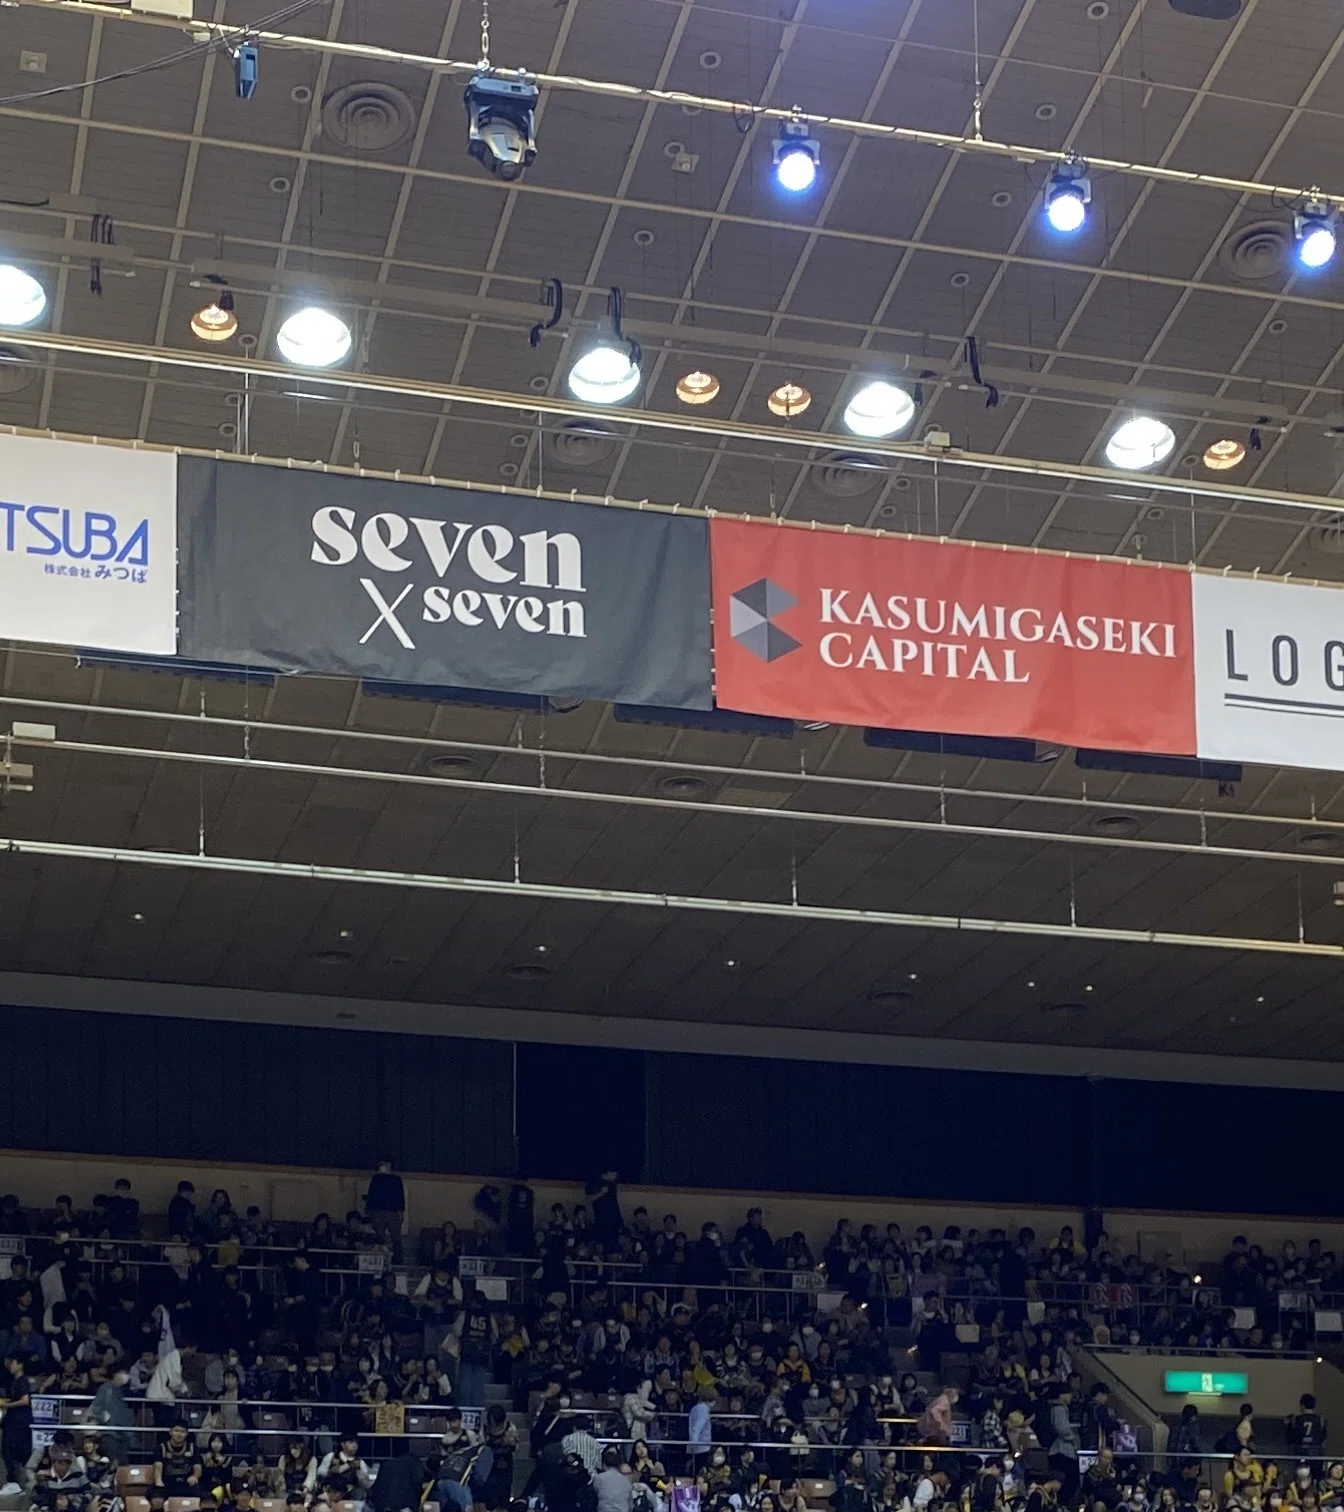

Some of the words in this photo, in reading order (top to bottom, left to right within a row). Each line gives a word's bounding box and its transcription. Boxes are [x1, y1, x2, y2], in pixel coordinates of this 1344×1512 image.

[44, 563, 91, 579] 株式会社
[94, 563, 148, 585] みつば
[311, 506, 587, 592] seven
[422, 585, 587, 638] seven
[819, 589, 1177, 658] KASUMIGASEKI
[819, 633, 1031, 683] CAPITAL
